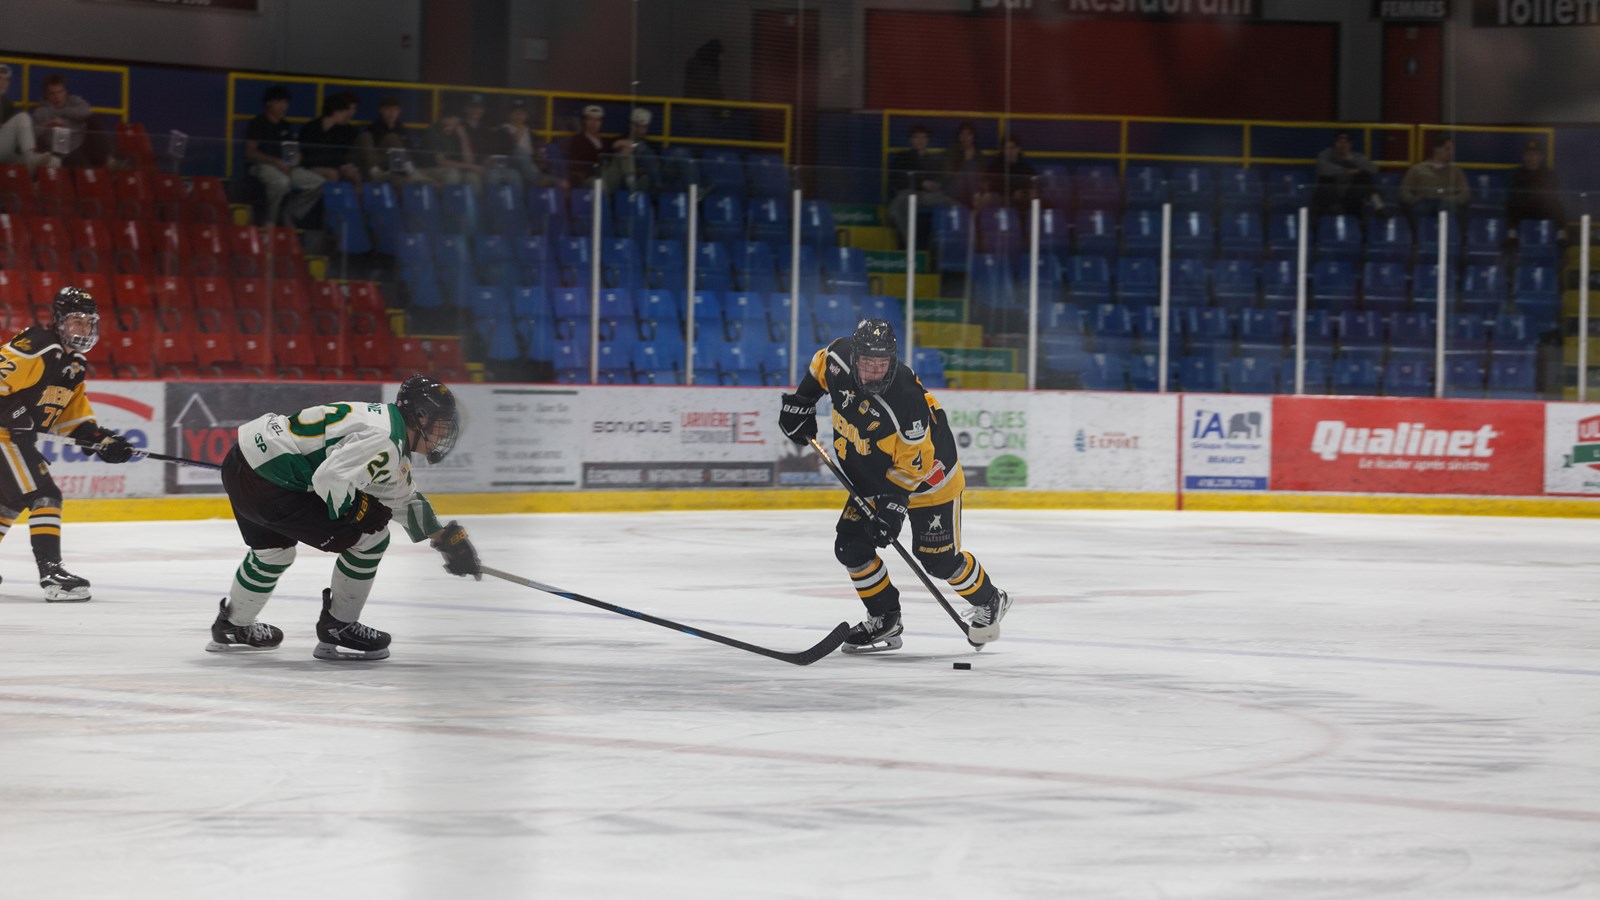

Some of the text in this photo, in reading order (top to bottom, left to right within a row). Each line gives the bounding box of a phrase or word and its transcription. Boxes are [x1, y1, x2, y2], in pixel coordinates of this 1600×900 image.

[873, 328, 881, 337] 4
[0, 354, 17, 379] 2
[592, 420, 673, 435] sonxplus
[1193, 409, 1226, 439] iA
[184, 428, 239, 464] YO
[834, 437, 848, 460] 4
[1311, 420, 1497, 461] Qualinet
[910, 448, 923, 472] 4
